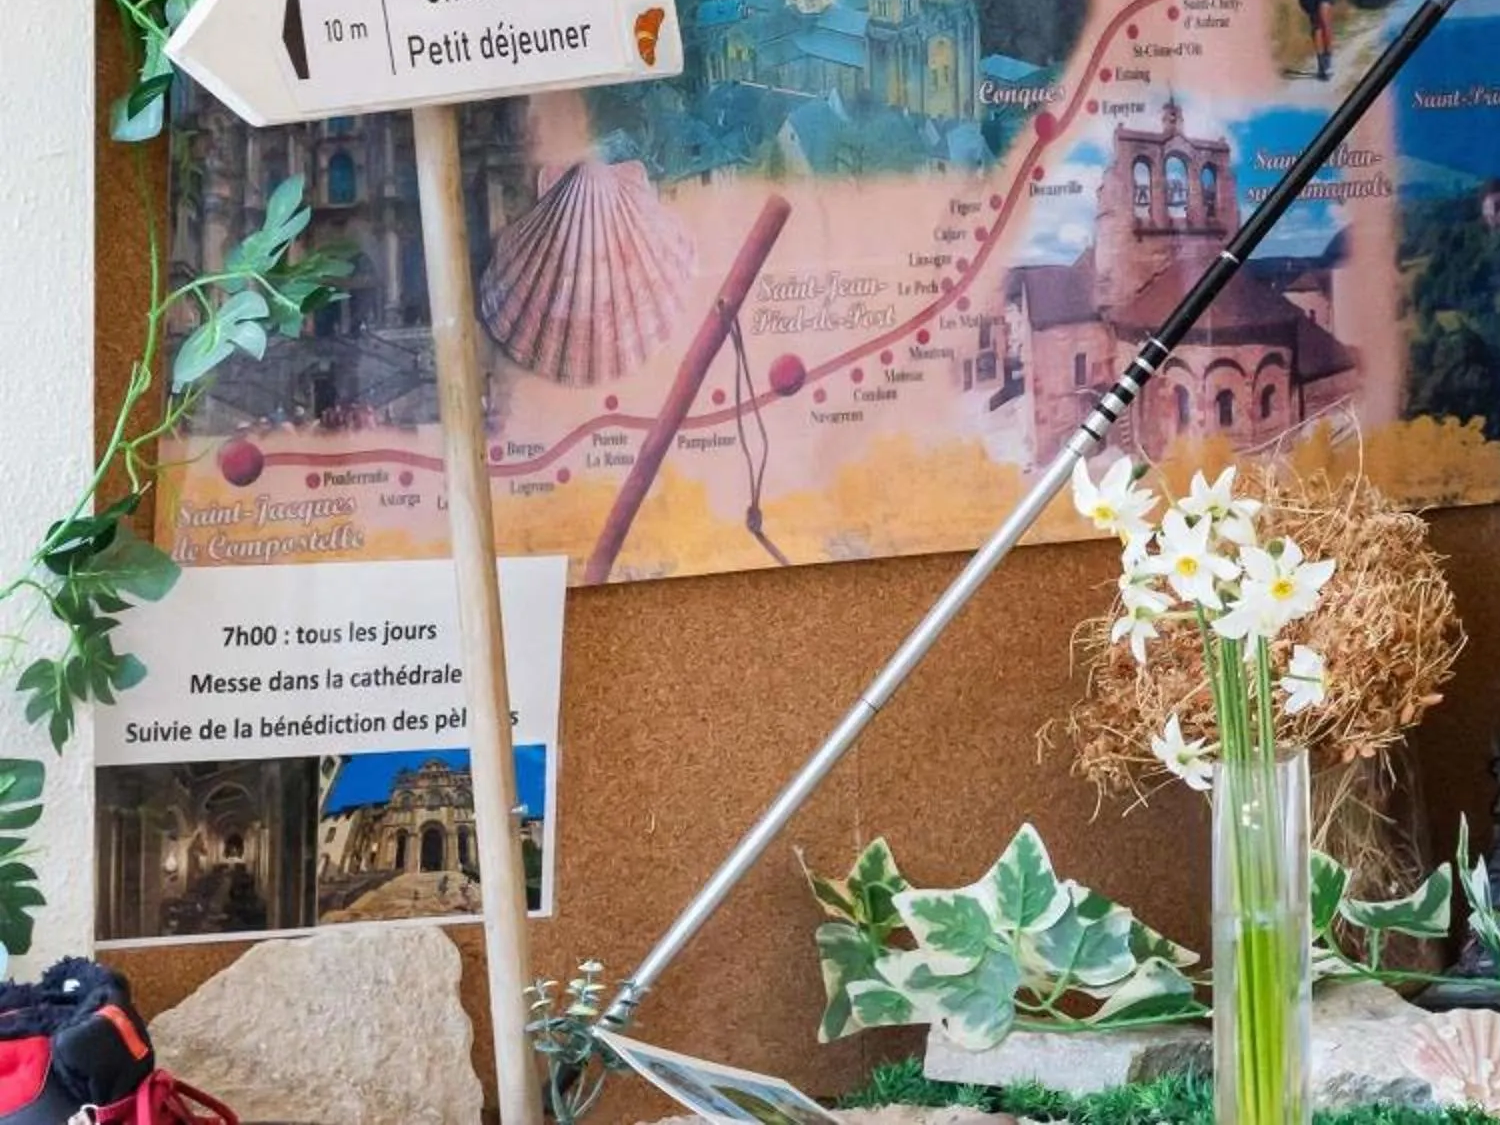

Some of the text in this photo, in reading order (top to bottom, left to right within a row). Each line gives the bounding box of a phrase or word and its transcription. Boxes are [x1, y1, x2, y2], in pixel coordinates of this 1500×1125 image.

[325, 19, 368, 43] 10 m
[408, 22, 592, 68] Petit déjeuner
[978, 81, 1066, 109] Conques
[177, 494, 358, 528] Saint-Jacques
[171, 523, 365, 562] de Compostelle
[223, 625, 277, 648] 7h00
[296, 623, 342, 644] tous
[349, 621, 376, 643] les
[382, 620, 437, 645] jours
[190, 663, 463, 695] Messe dans la cathédrale
[125, 719, 192, 744] Suivie
[198, 719, 226, 741] de
[233, 717, 253, 739] la
[260, 712, 386, 737] bénédiction
[392, 710, 428, 732] des
